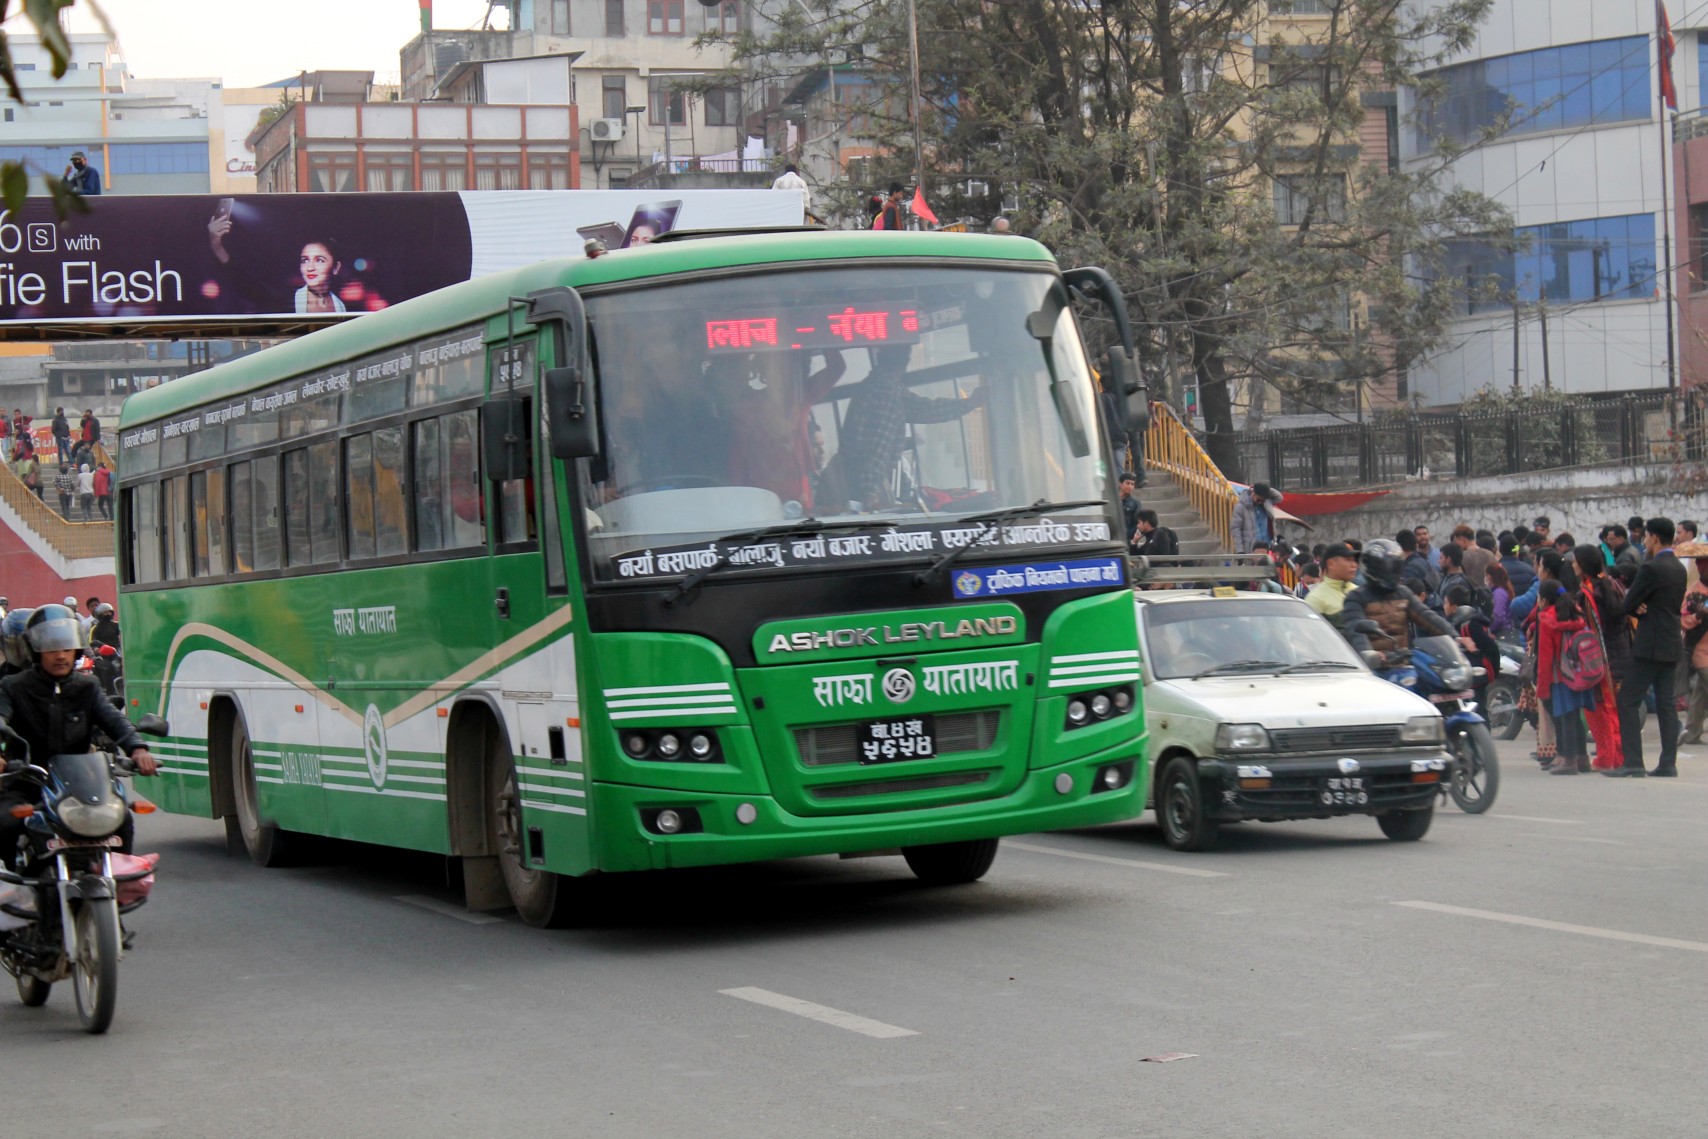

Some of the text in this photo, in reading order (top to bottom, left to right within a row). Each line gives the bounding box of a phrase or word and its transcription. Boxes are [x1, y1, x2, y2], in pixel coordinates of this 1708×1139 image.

[64, 234, 100, 250] with
[62, 259, 182, 304] Flash
[357, 605, 397, 635] यातायात
[768, 615, 1017, 653] ASHOK LEYLAND
[812, 660, 1019, 707] साझा यातायात
[862, 735, 933, 761] ५६५४
